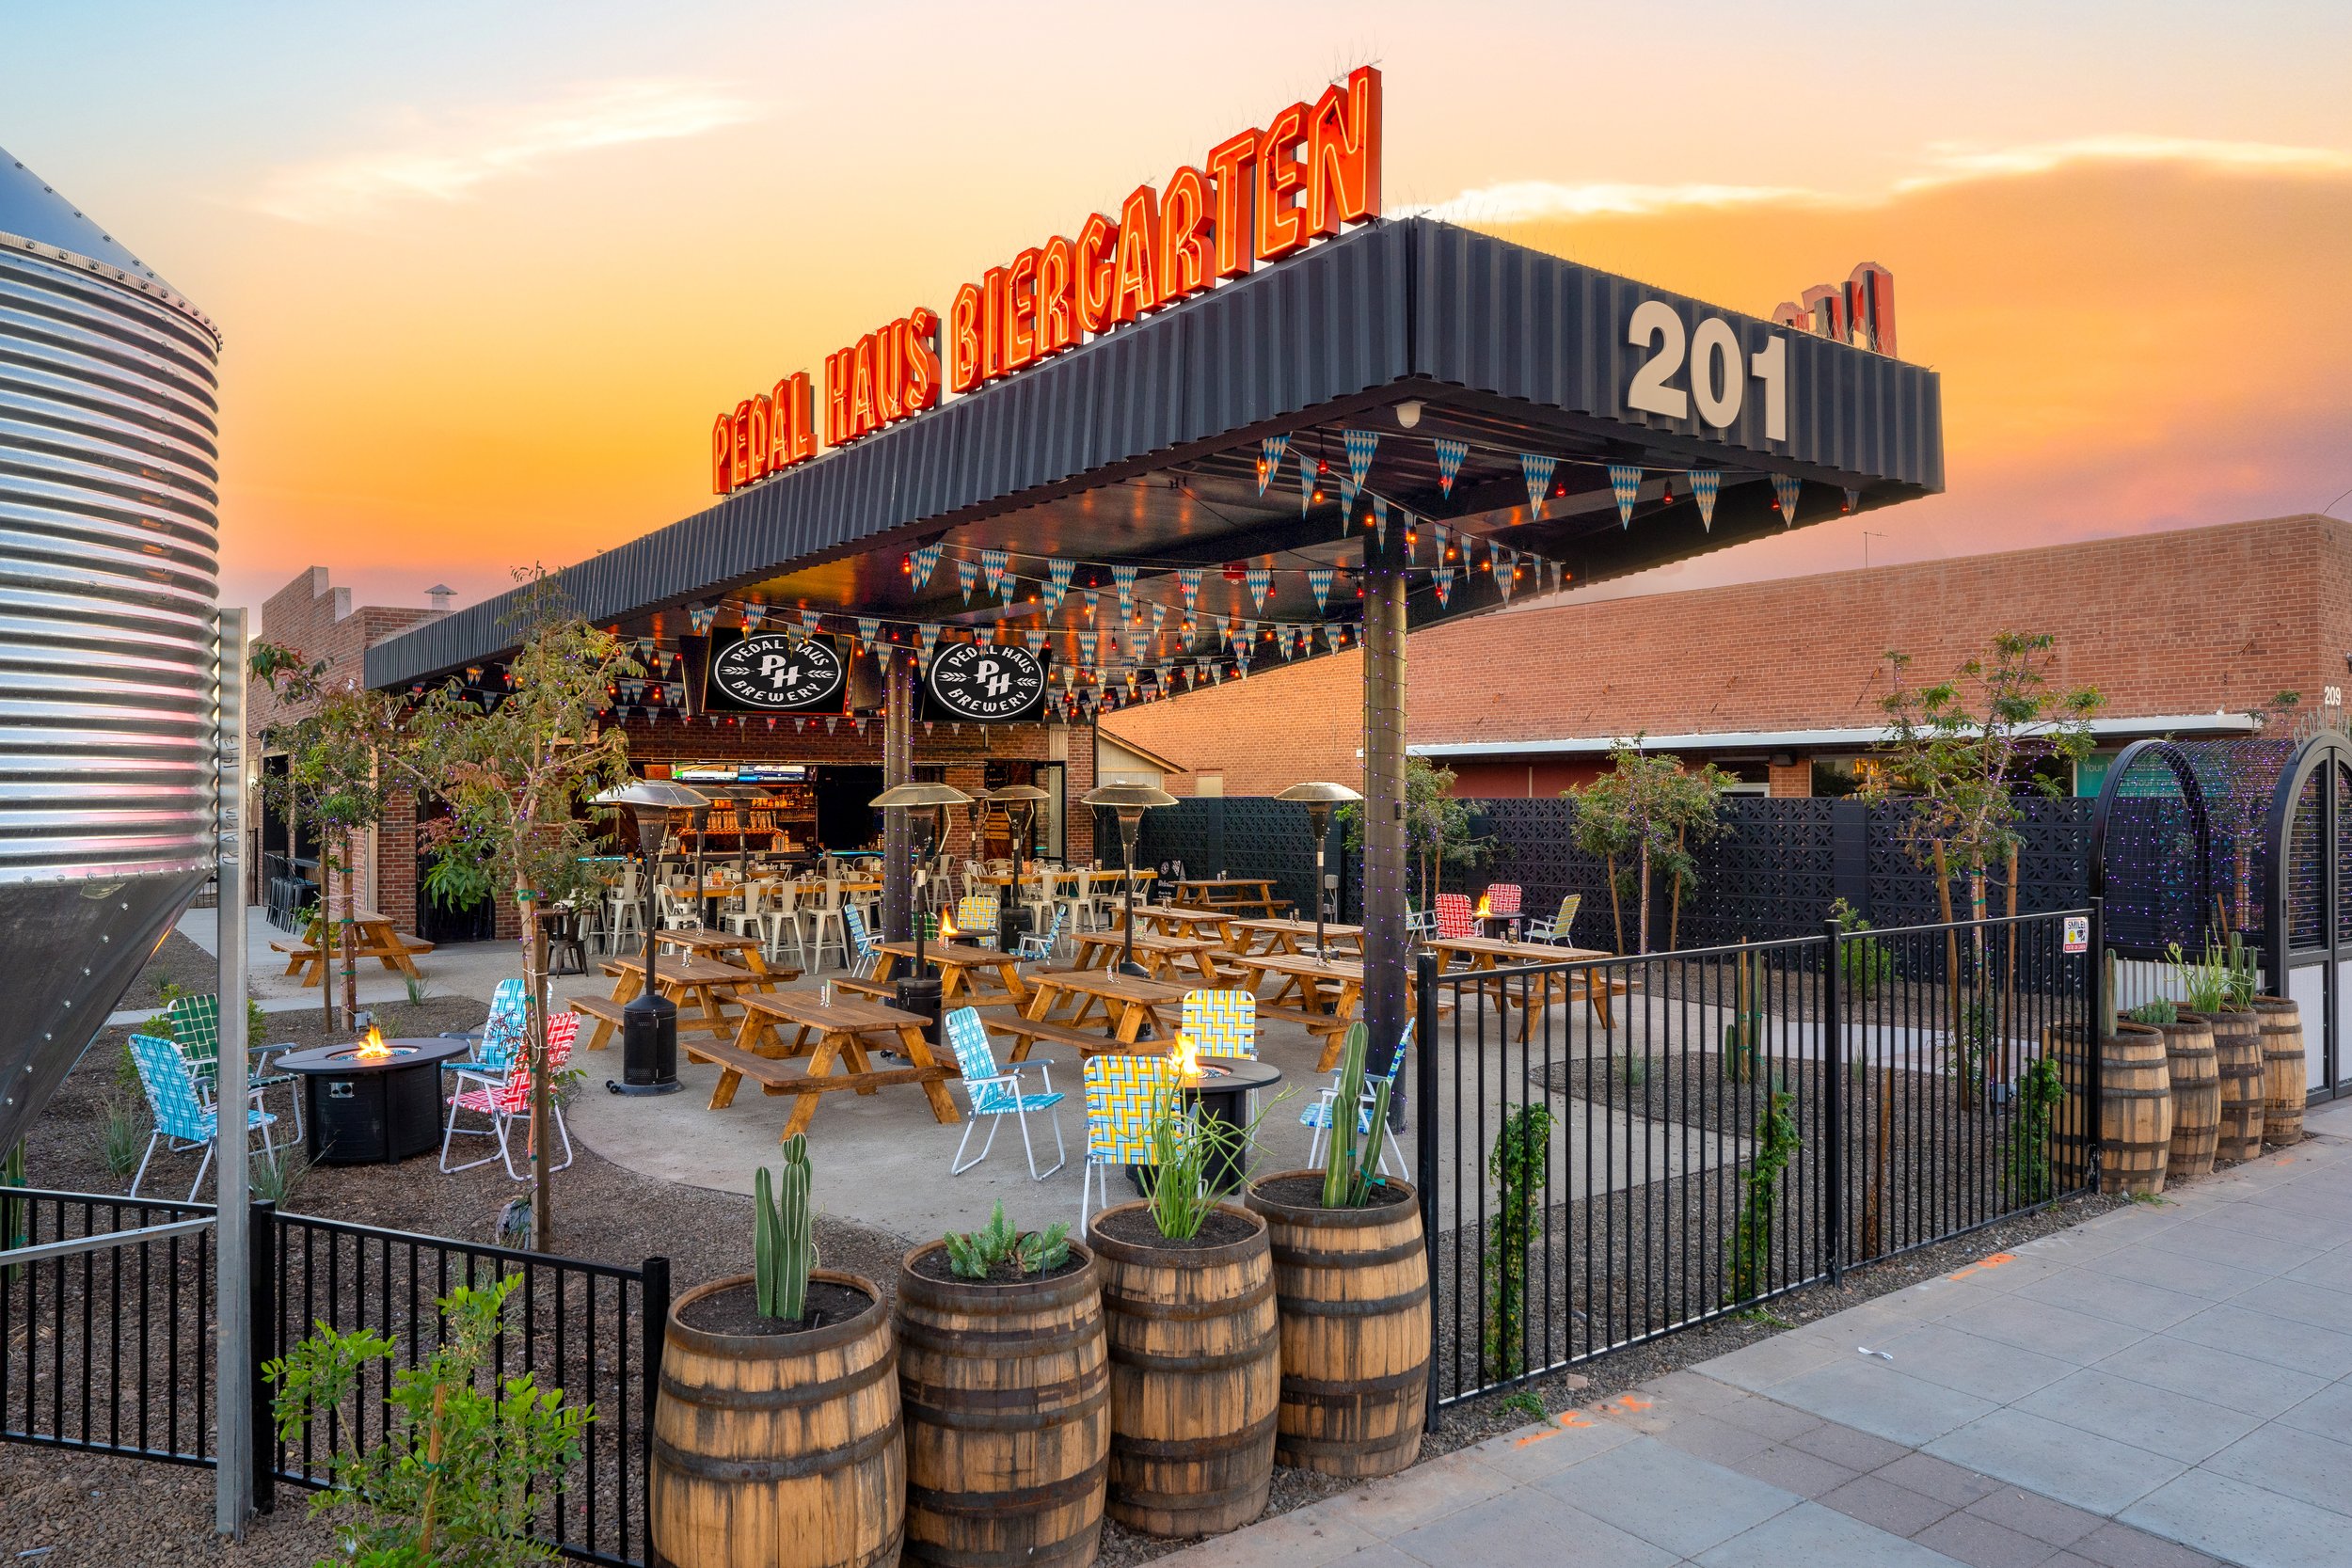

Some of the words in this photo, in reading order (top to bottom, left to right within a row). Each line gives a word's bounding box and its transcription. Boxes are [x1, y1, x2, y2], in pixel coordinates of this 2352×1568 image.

[712, 372, 818, 495] PEDAL
[825, 307, 941, 448] HAUS
[951, 66, 1381, 393] BIERGARTEN
[1629, 300, 1786, 442] 201
[730, 640, 784, 662] PEDAL
[947, 645, 997, 667] PEDL
[1001, 647, 1035, 673] HAUS
[756, 654, 803, 689] PH
[973, 659, 1013, 697] PH
[731, 680, 821, 702] BREWERY
[947, 688, 1028, 712] BREWERY
[2324, 686, 2342, 706] 209
[2083, 763, 2104, 772] Your
